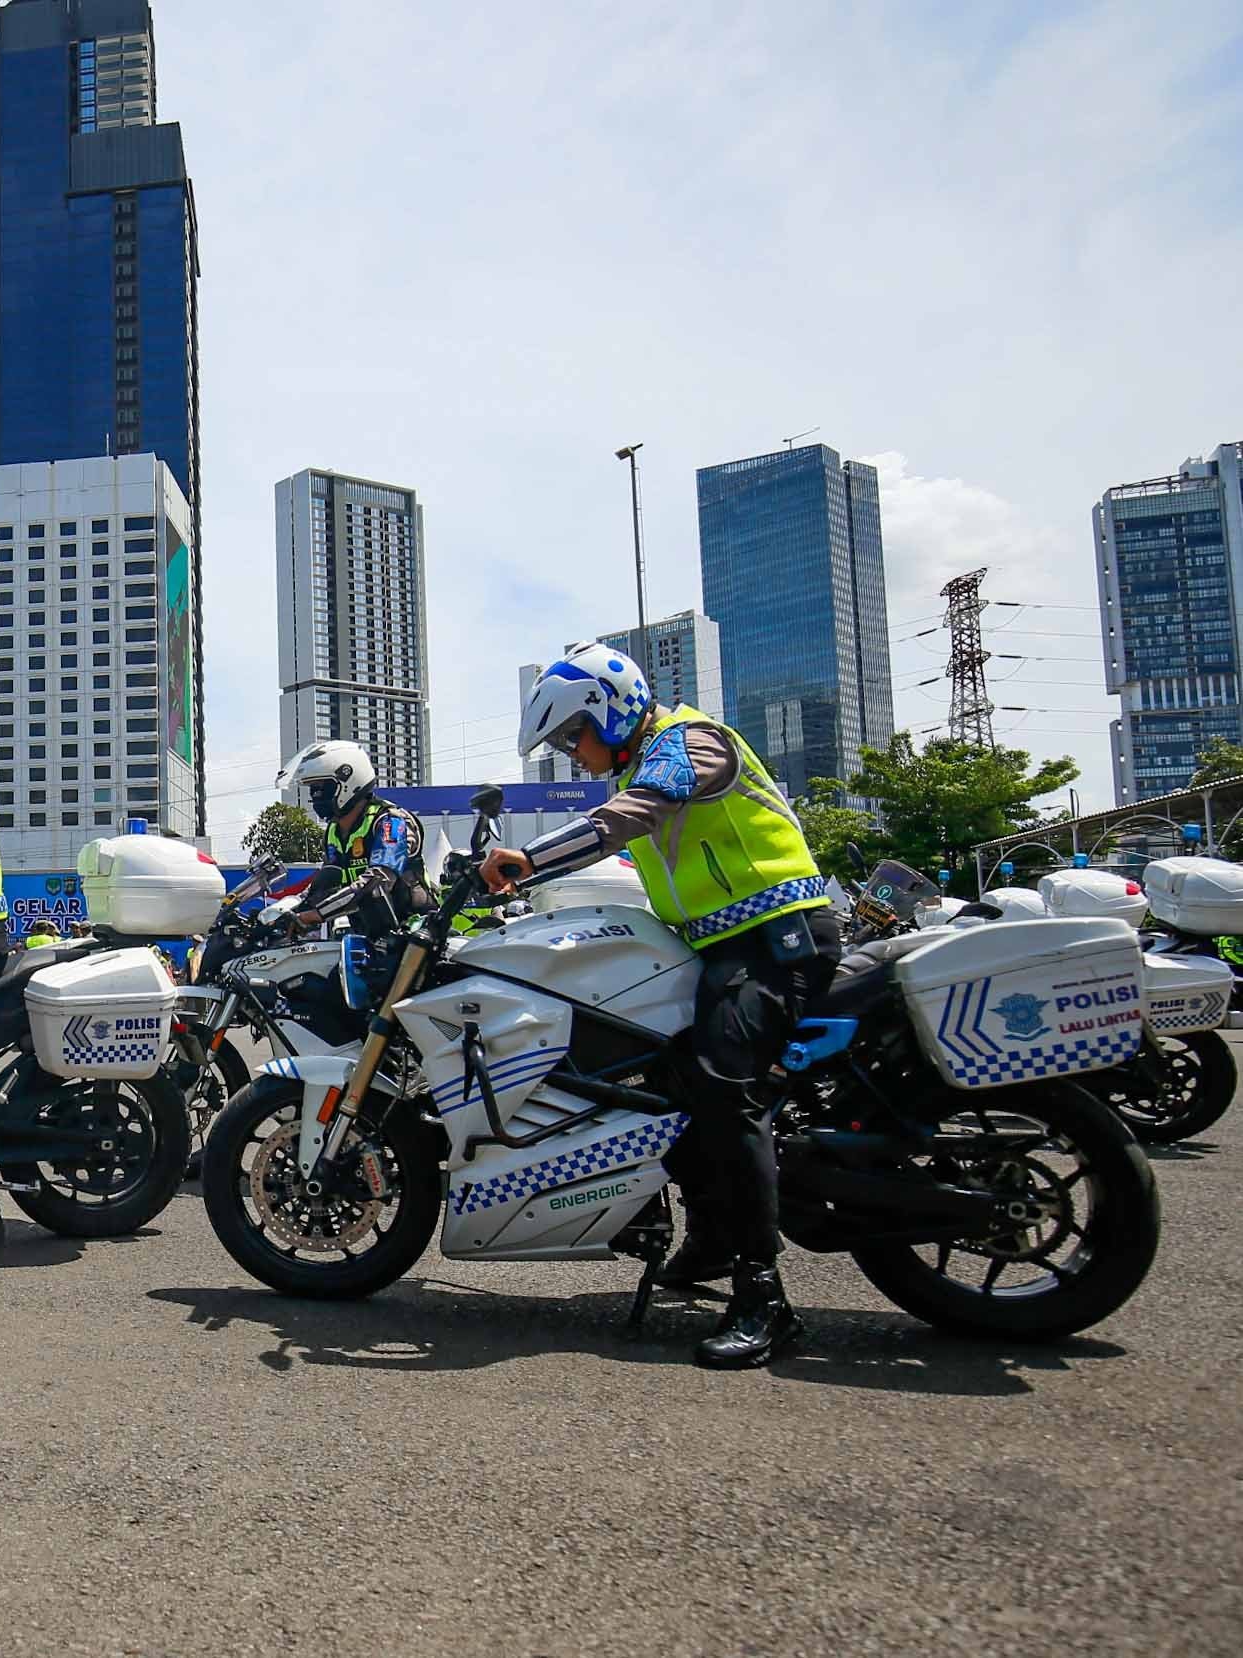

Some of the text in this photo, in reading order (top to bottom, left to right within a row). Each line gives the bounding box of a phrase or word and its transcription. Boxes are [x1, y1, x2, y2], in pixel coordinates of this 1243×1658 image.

[556, 791, 586, 800] YAMAHA
[13, 897, 83, 917] GELAR
[547, 924, 636, 945] POLISI
[1055, 983, 1140, 1013] POLISI
[115, 1017, 161, 1031] POLISI
[1059, 1009, 1141, 1035] LALU LINTAS
